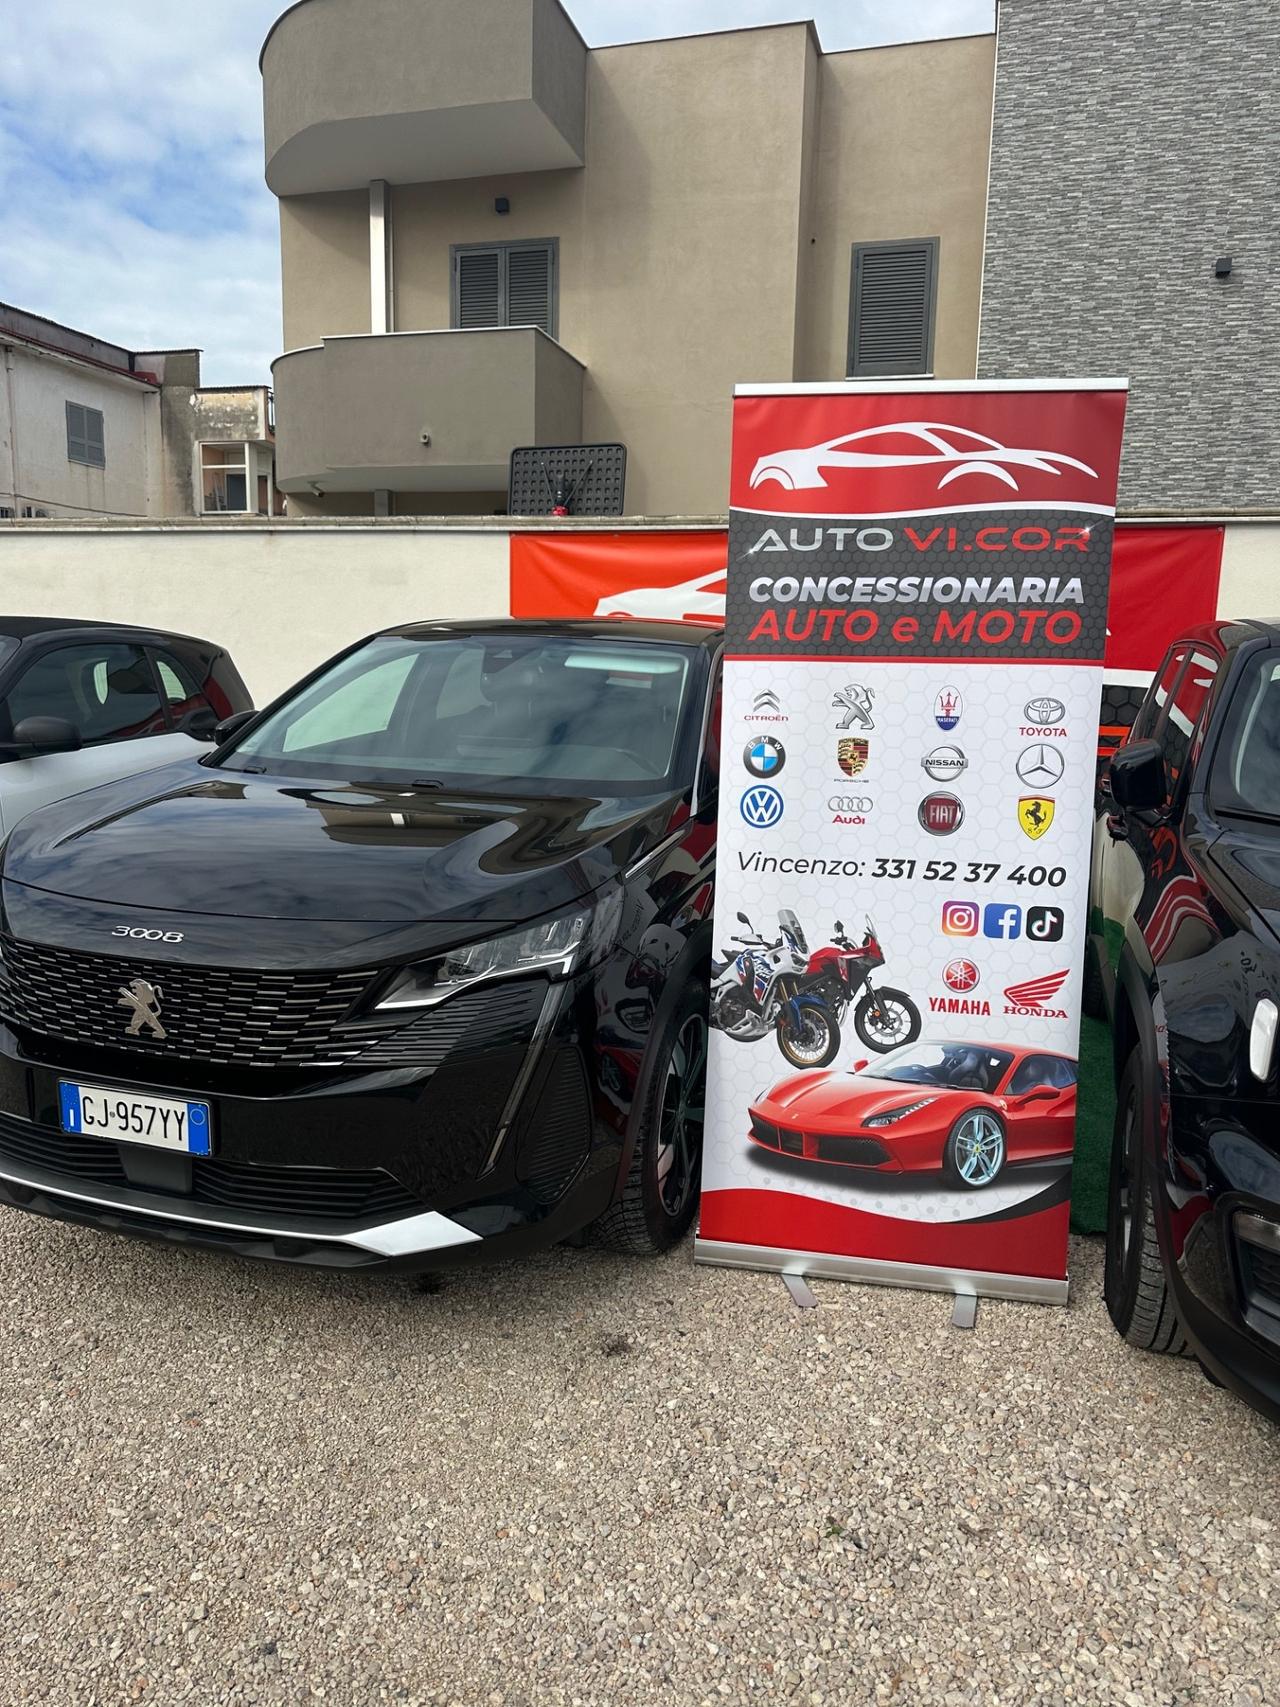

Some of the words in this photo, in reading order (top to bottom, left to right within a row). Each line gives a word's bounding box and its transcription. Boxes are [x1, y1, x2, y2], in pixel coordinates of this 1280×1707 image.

[750, 527, 894, 552] AUTO
[903, 526, 1090, 552] VI.COR
[748, 576, 1085, 605] CONCESSIONARIA
[747, 609, 879, 642] AUTO
[891, 614, 919, 642] e
[933, 609, 1082, 645] MOTO
[1018, 726, 1068, 737] TOYOTA
[925, 758, 965, 767] NISSAN
[832, 814, 866, 825] Audi
[929, 804, 956, 824] FIAT
[737, 851, 866, 877] Vincenzo:
[870, 857, 916, 880] 331
[922, 860, 957, 882] 52
[963, 862, 1002, 884] 37
[1006, 865, 1067, 888] 400
[111, 925, 184, 943] 3008
[928, 996, 991, 1016] YAMAHA
[1002, 1005, 1069, 1019] HONDA
